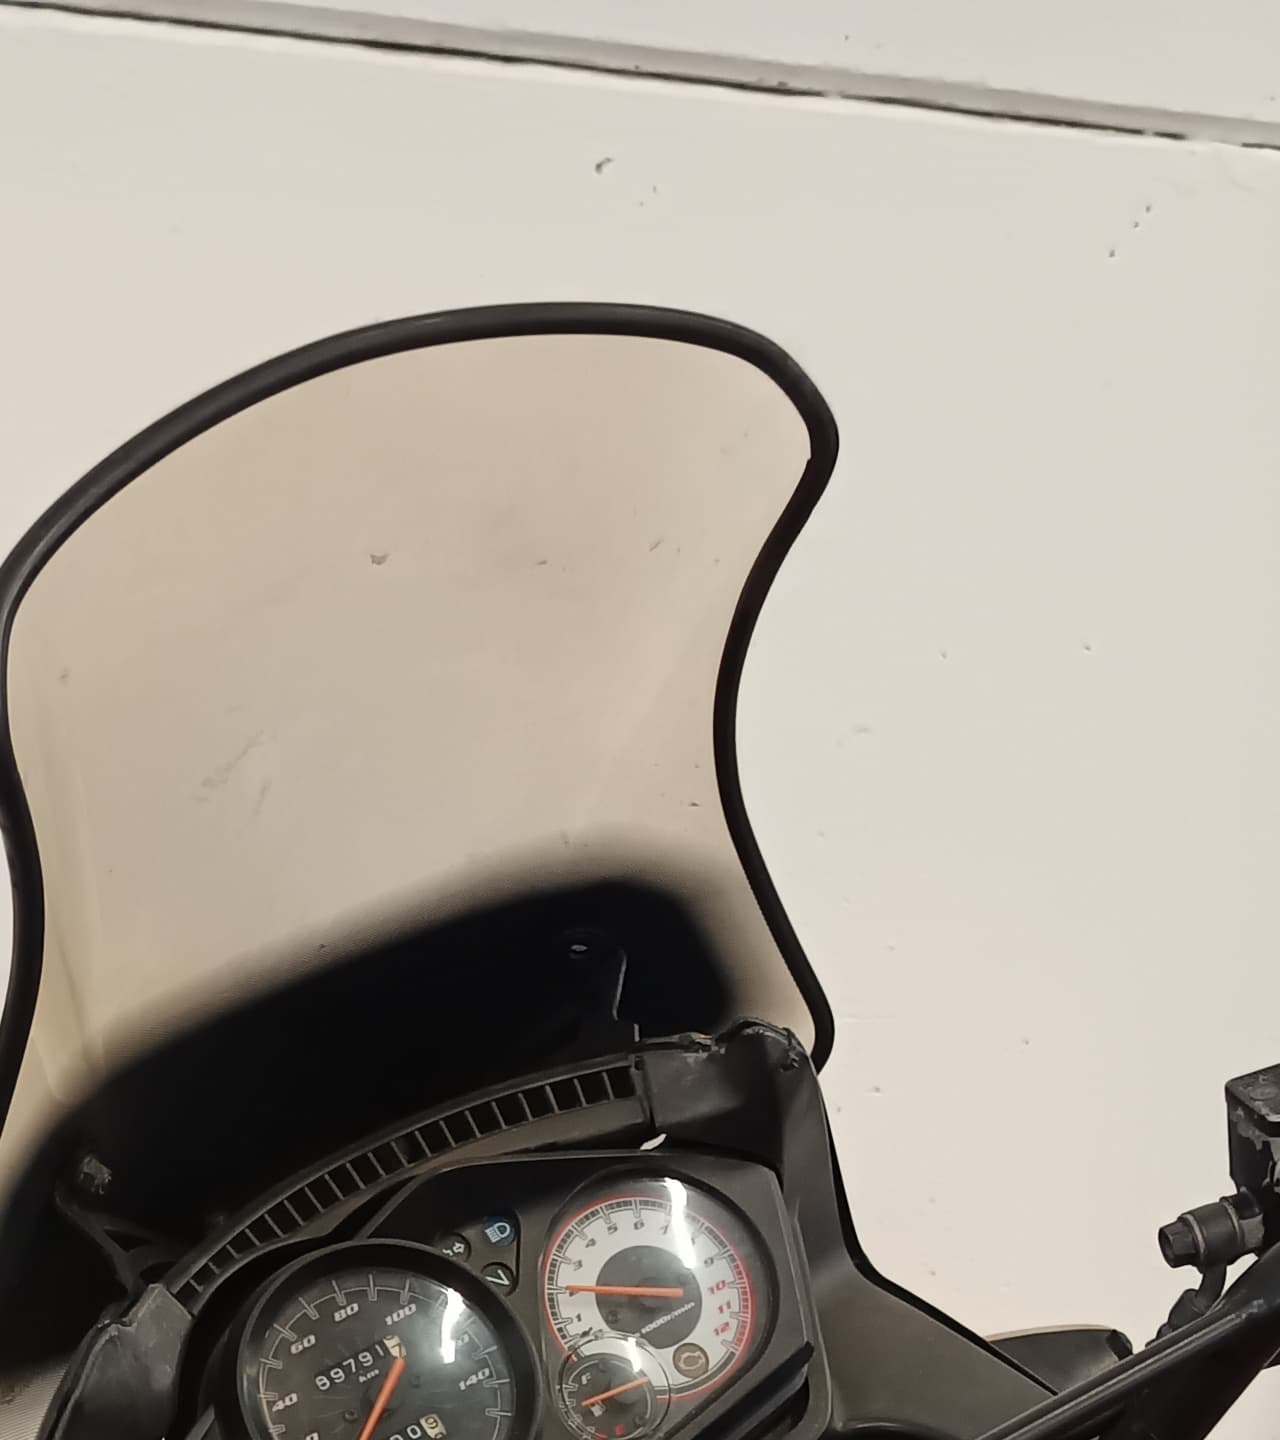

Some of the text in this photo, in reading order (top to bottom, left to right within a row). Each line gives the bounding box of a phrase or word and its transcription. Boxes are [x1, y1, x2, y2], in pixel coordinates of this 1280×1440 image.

[607, 1224, 618, 1235] 5
[633, 1220, 645, 1231] 6
[585, 1238, 596, 1249] 4
[707, 1280, 726, 1295] 10
[334, 1303, 359, 1322] 80
[385, 1303, 417, 1326] 100
[718, 1301, 731, 1313] 11
[713, 1321, 730, 1336] 12
[290, 1334, 316, 1354] 60
[359, 1369, 380, 1383] km
[459, 1367, 489, 1390] 140
[272, 1393, 298, 1412] 40
